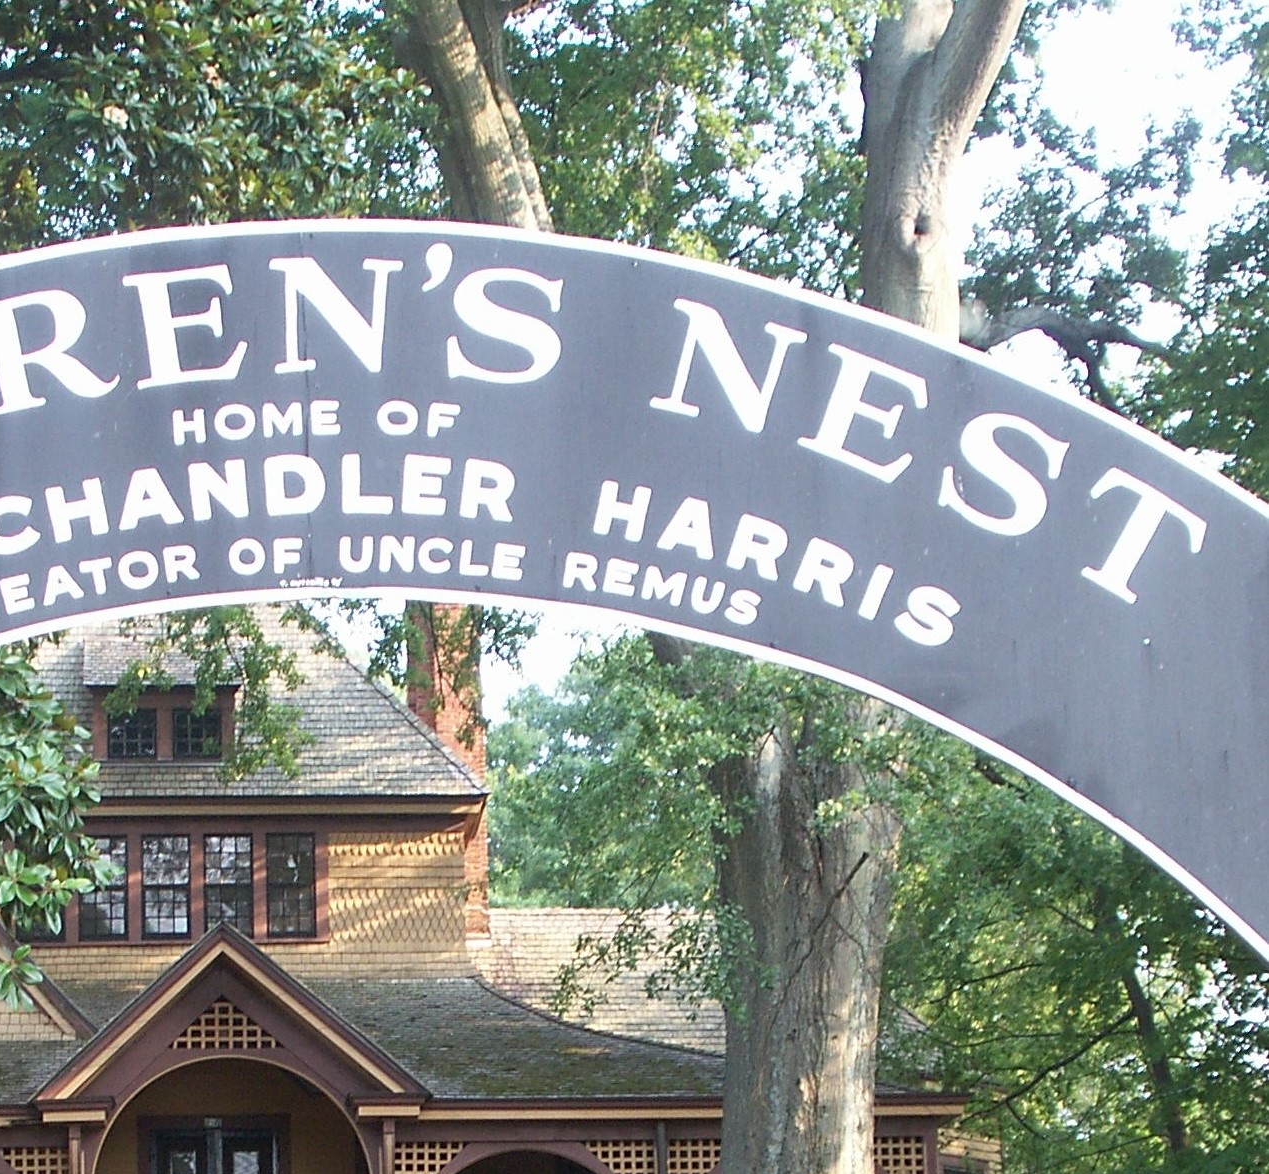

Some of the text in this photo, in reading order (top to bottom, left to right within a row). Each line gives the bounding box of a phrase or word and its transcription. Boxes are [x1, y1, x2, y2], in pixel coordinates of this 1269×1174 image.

[171, 399, 462, 447] HOME OF
[649, 297, 1208, 605] NEST
[227, 537, 304, 577] OF
[337, 535, 529, 584] UNCLE
[561, 551, 762, 628] REMUS
[591, 479, 962, 648] HARRIS
